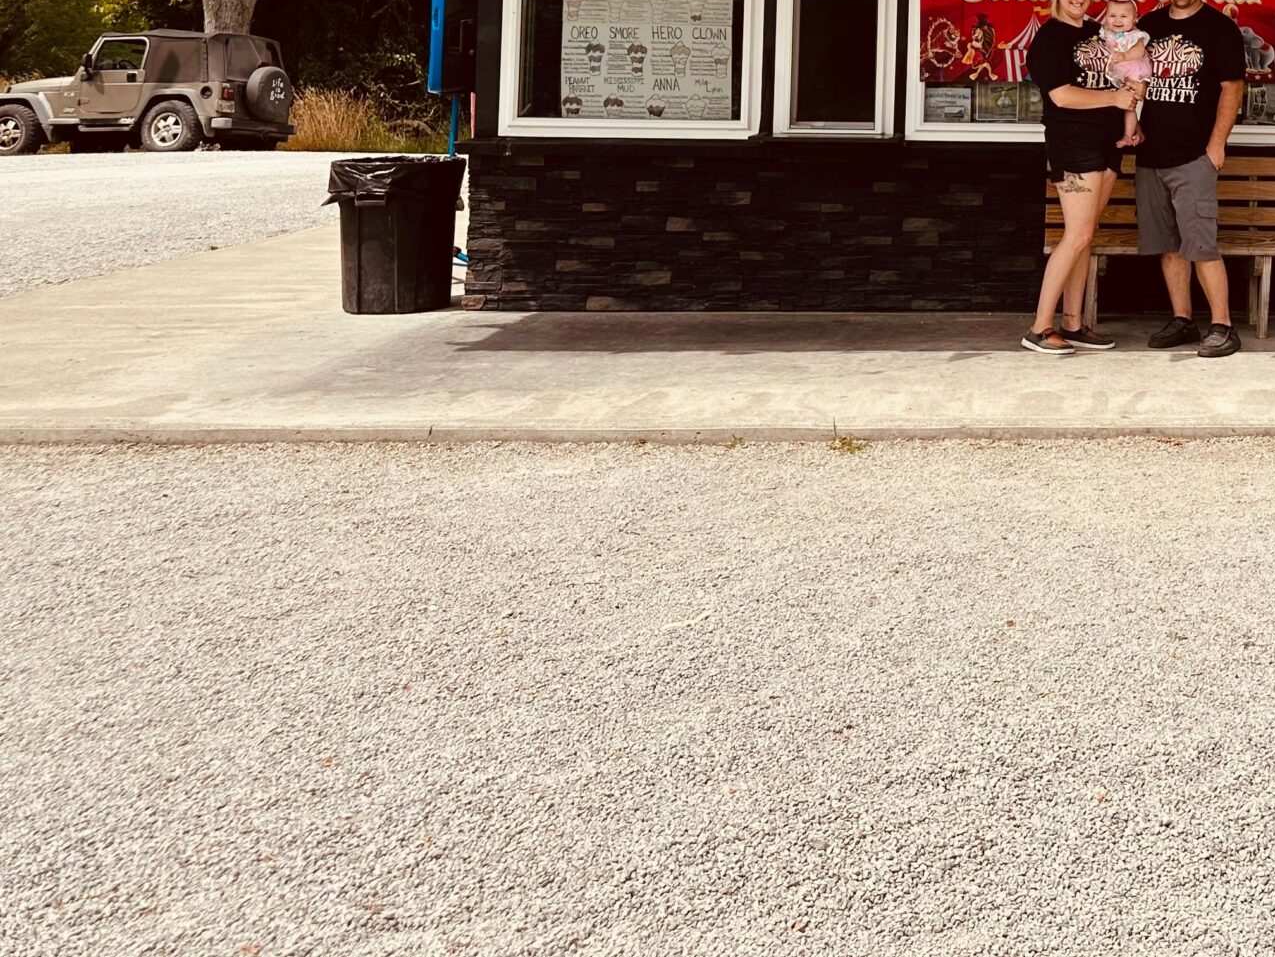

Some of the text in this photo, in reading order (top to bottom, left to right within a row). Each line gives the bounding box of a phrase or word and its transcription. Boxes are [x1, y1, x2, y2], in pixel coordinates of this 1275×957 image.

[571, 25, 599, 40] OREO
[609, 26, 640, 40] SMORE
[651, 25, 683, 40] HERO
[692, 26, 727, 41] CLOWN
[272, 78, 284, 88] Life
[617, 85, 636, 93] MUD
[652, 78, 681, 91] ANNA
[1147, 76, 1195, 90] RNIVAL
[1145, 87, 1199, 104] CURITY
